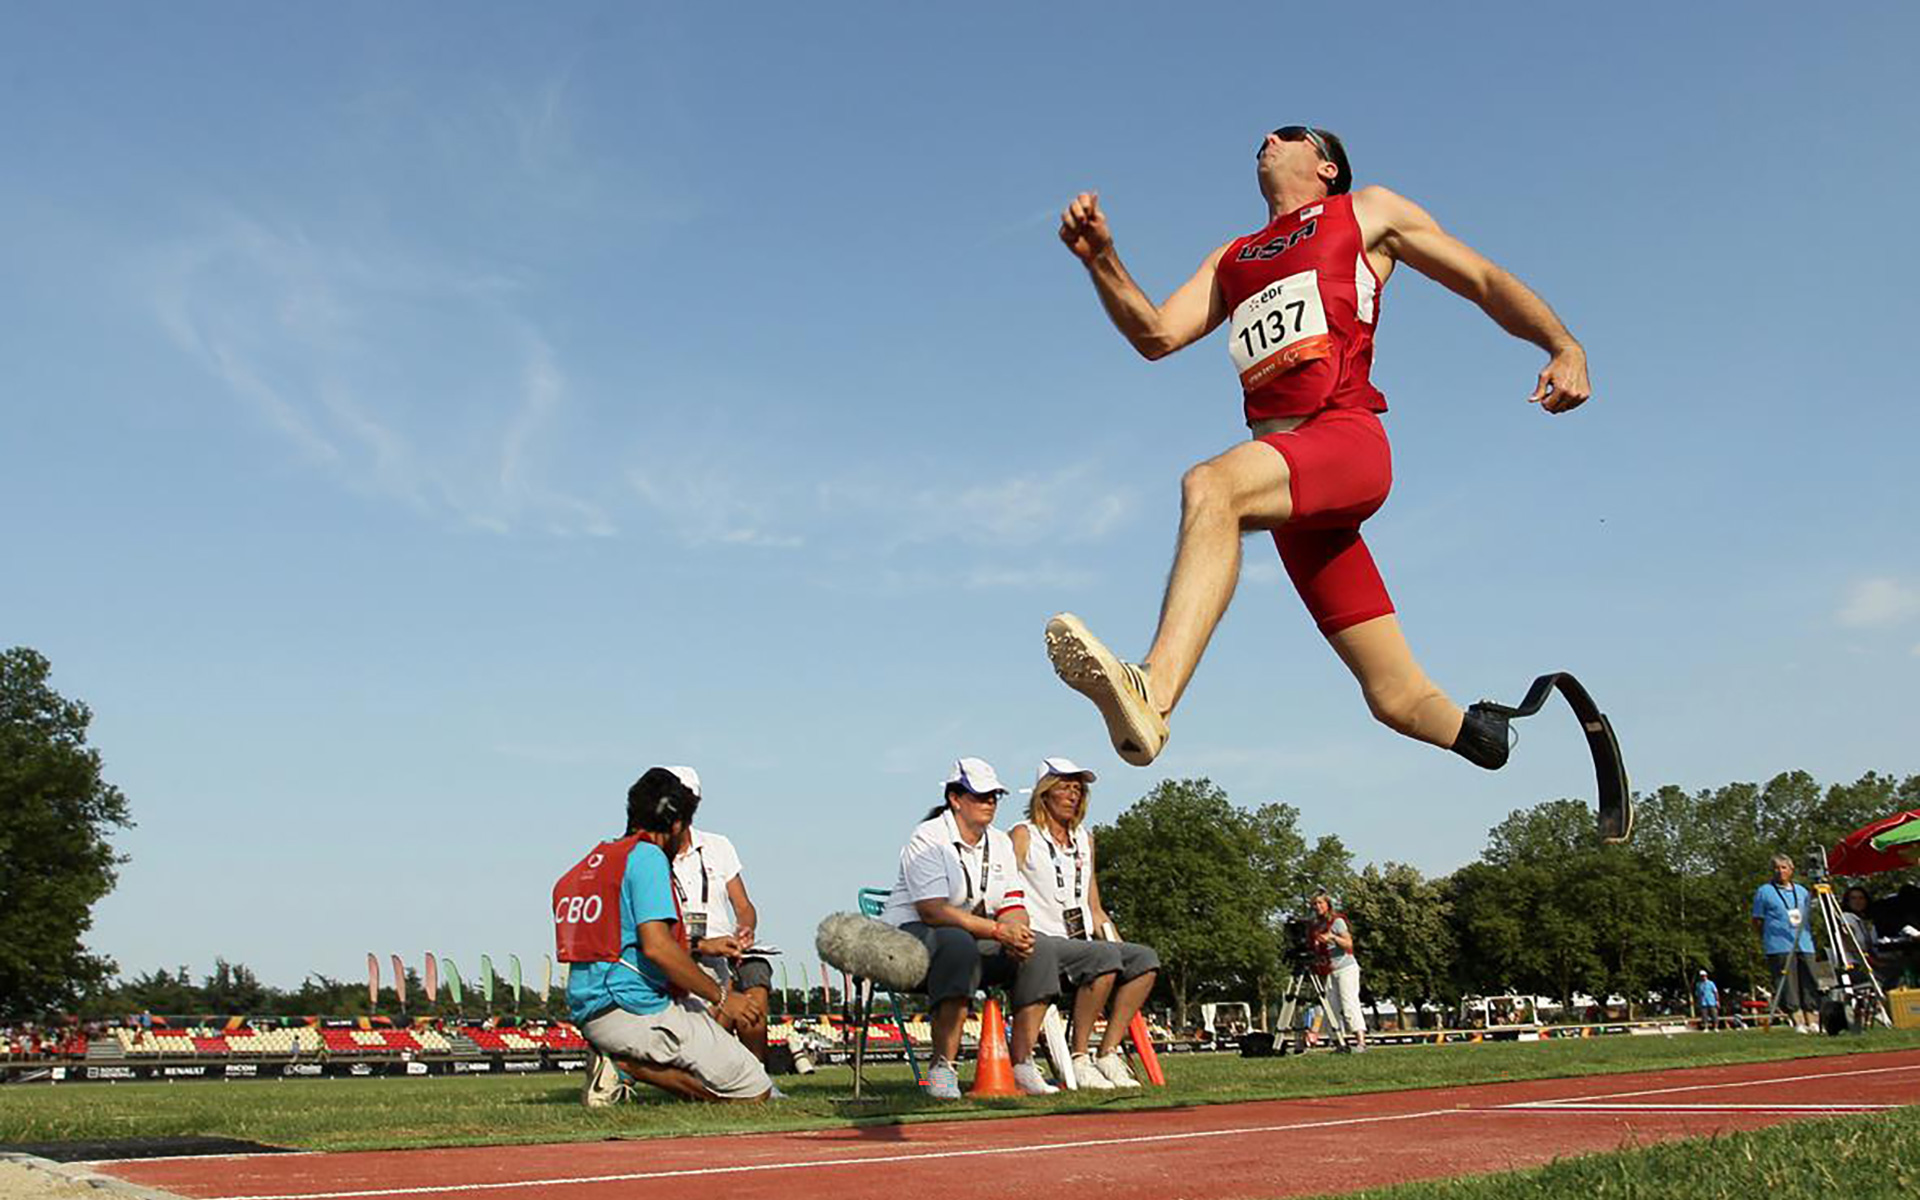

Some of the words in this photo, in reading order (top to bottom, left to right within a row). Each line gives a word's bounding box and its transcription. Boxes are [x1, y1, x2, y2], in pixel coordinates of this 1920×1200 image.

[1236, 219, 1317, 261] USA
[1238, 300, 1306, 358] 1137
[555, 895, 602, 924] CBO
